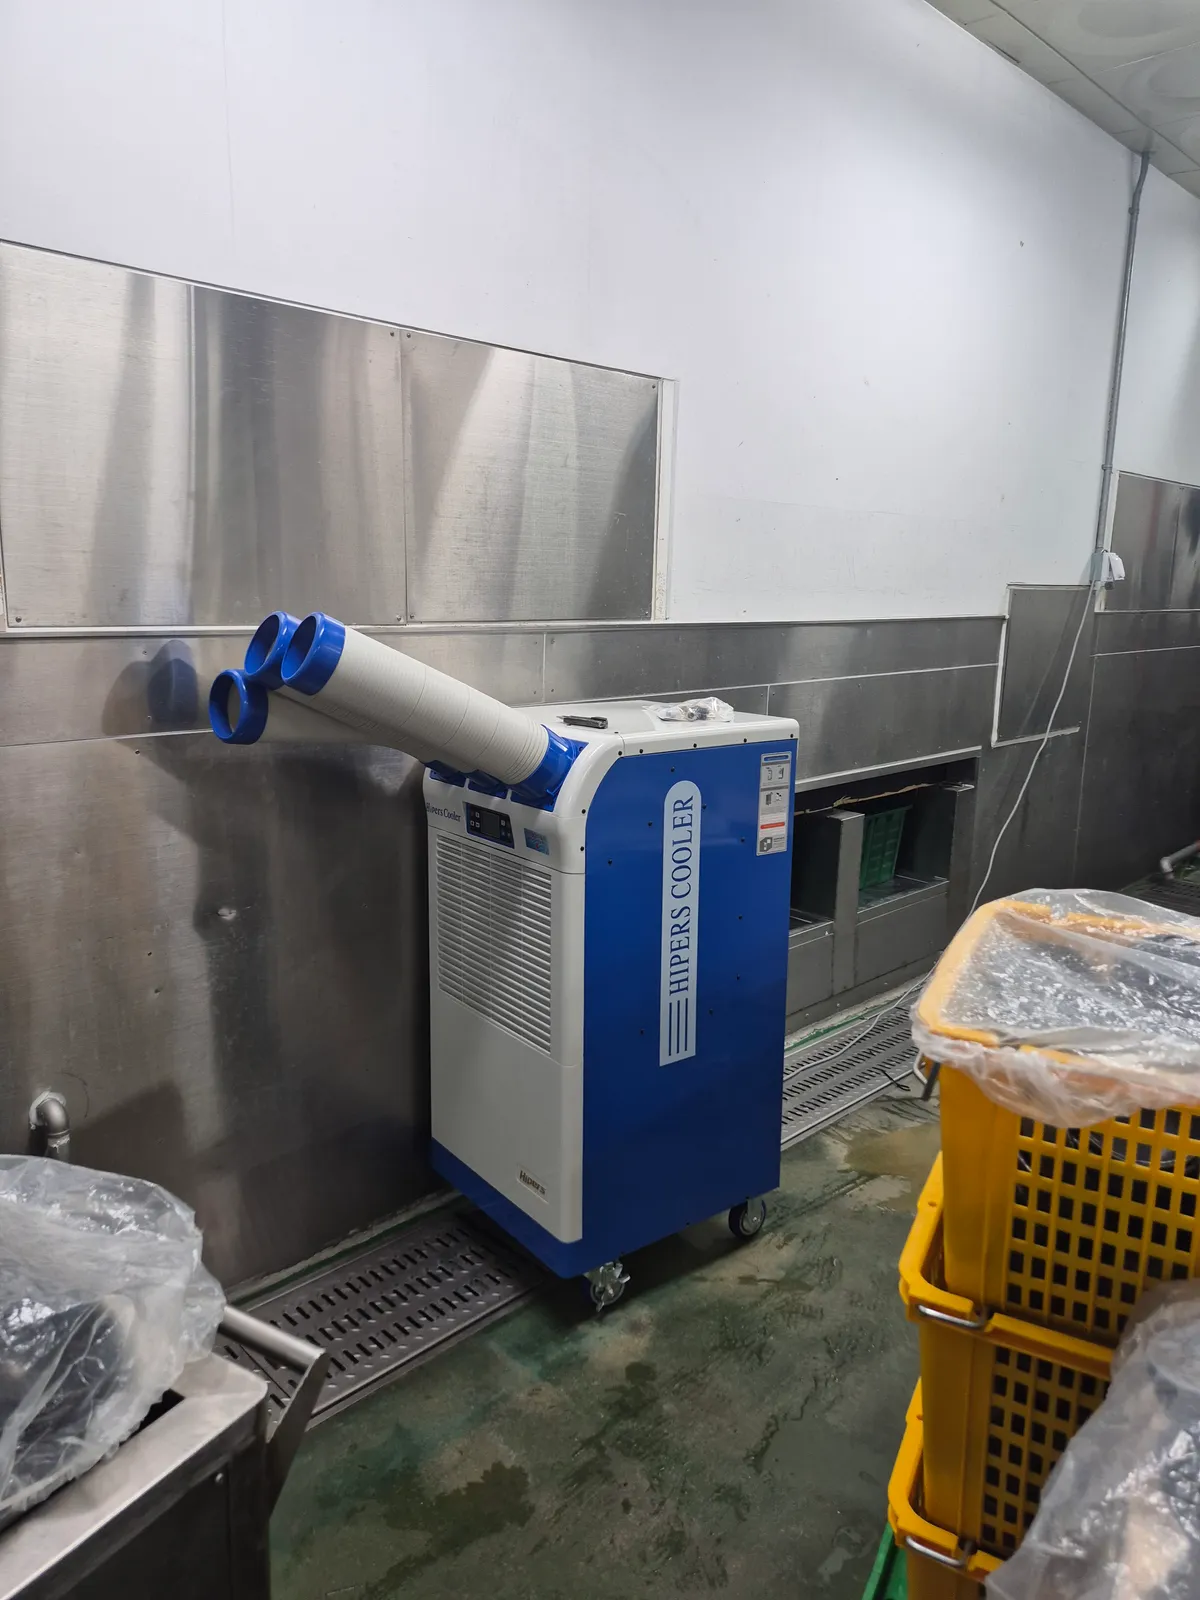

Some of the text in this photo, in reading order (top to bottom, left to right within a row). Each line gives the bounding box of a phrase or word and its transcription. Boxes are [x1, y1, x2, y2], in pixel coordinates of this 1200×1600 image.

[443, 808, 461, 822] Cooler
[669, 795, 694, 996] HIPERS COOLER
